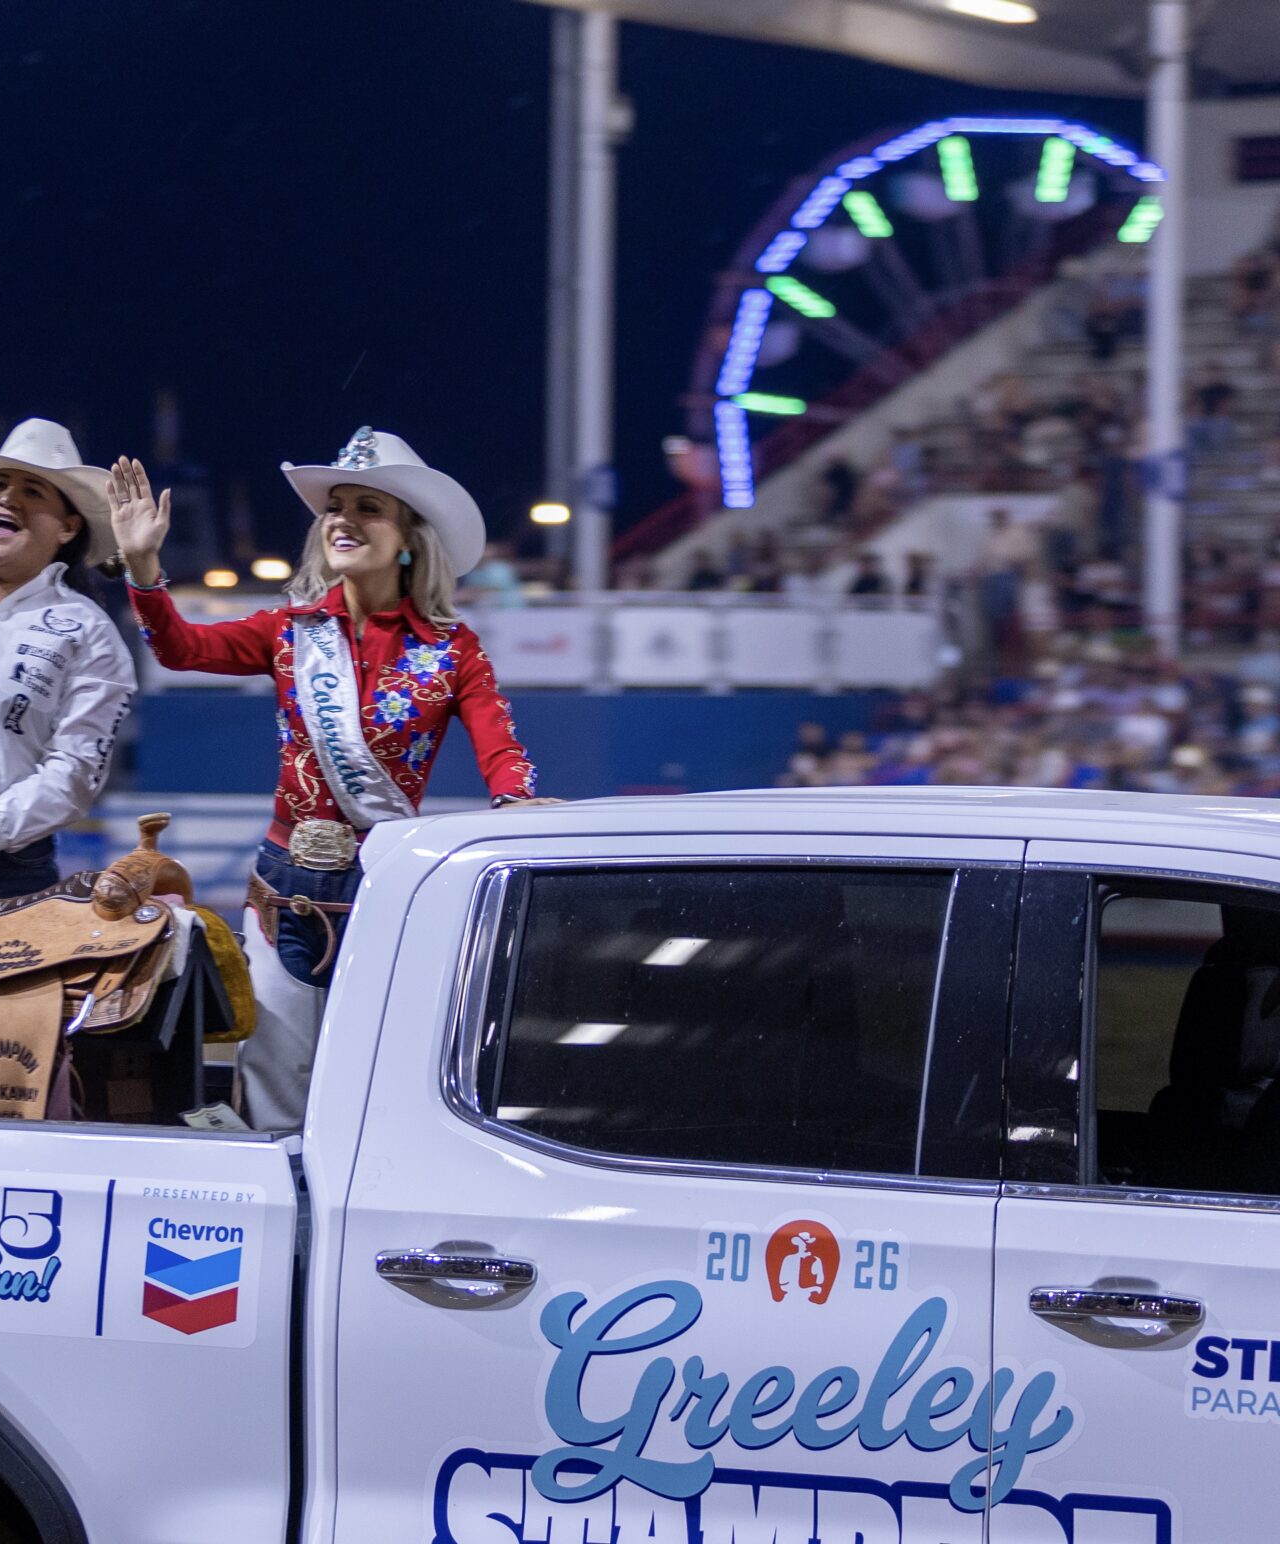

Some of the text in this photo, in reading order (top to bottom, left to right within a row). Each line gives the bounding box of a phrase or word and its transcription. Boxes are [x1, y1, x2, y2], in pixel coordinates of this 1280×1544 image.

[310, 672, 368, 798] Colorado
[143, 1186, 255, 1203] PRESENTED BY
[148, 1217, 244, 1243] Chevron
[706, 1231, 900, 1291] 20 26
[1192, 1335, 1280, 1383] ST
[531, 1279, 1074, 1514] Greeley
[1192, 1386, 1280, 1417] PARA
